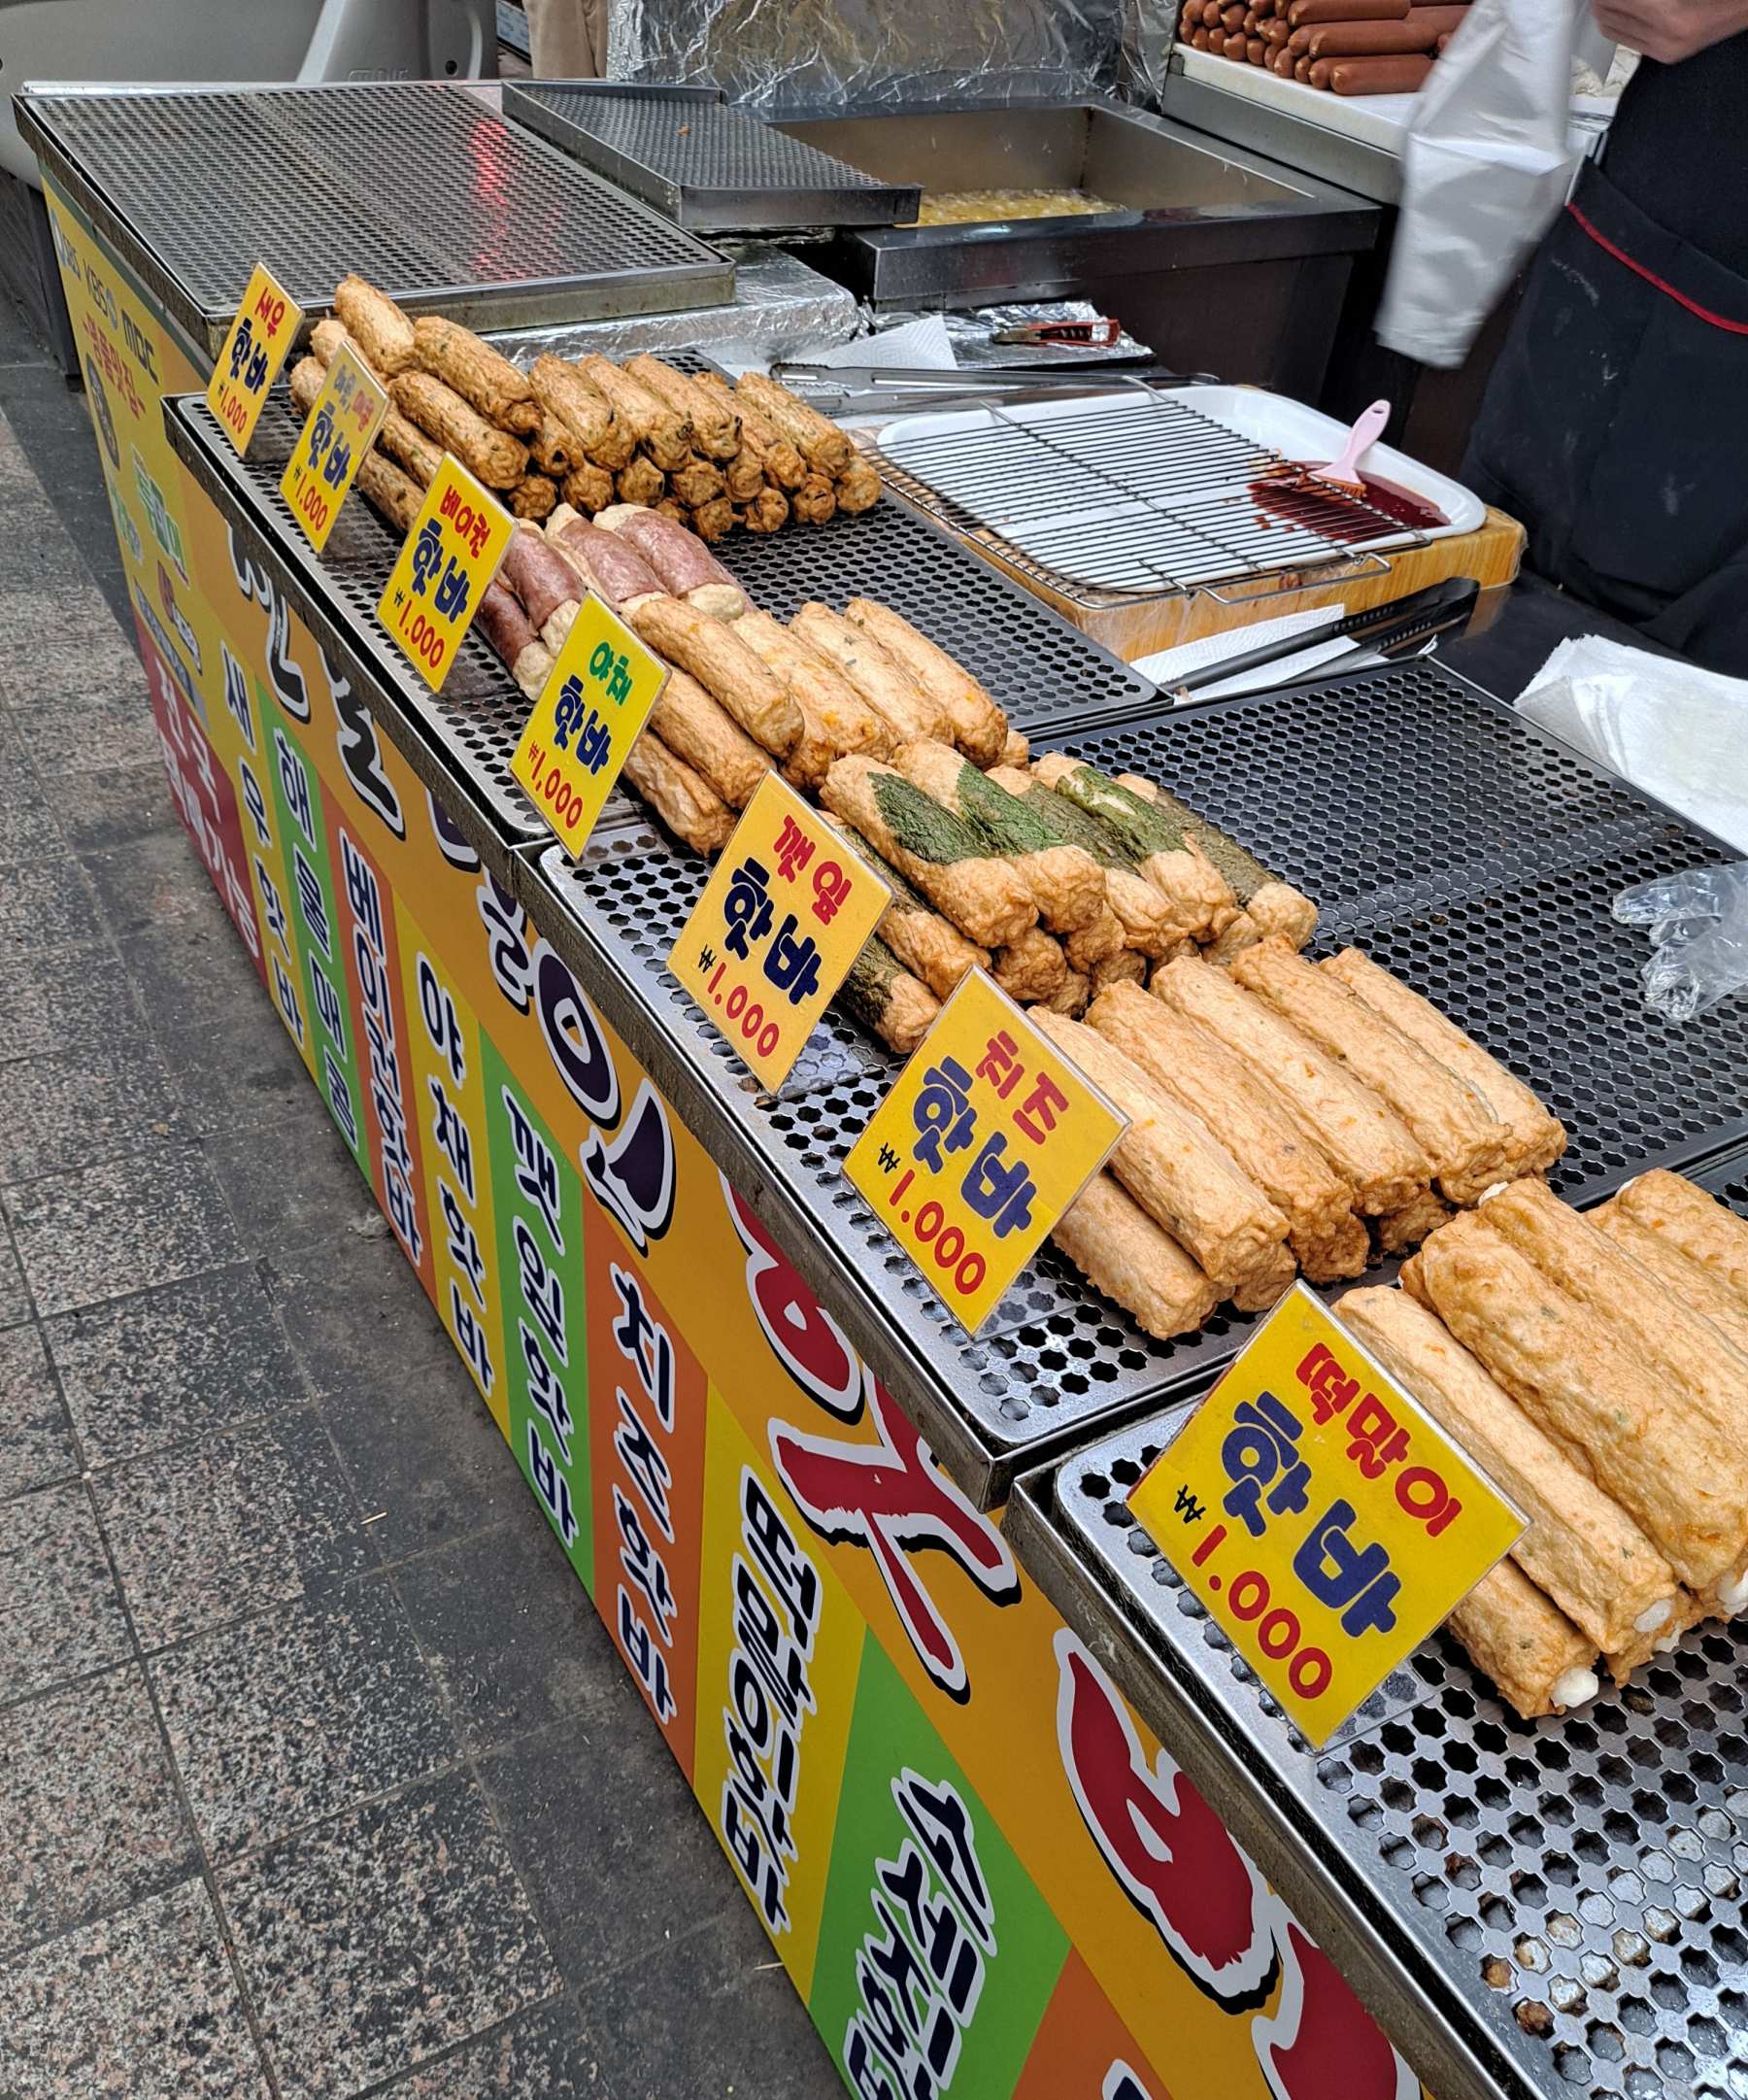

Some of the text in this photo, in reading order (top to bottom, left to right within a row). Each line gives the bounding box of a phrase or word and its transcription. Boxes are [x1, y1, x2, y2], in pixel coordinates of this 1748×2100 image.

[121, 309, 159, 387] MBC
[230, 316, 268, 395] 핫바
[254, 288, 286, 338] 새우
[309, 399, 351, 491] 핫바
[412, 518, 471, 624] 핫바
[439, 485, 492, 560] 베이컨
[555, 674, 612, 775] 핫바
[589, 641, 633, 706] 야채
[773, 814, 854, 927] 깻잎
[723, 856, 823, 1006] 핫바
[975, 1030, 1070, 1146] 치즈
[912, 1055, 1038, 1238] 핫바
[1295, 1342, 1463, 1539] 떡말이
[1221, 1390, 1403, 1639] 핫바
